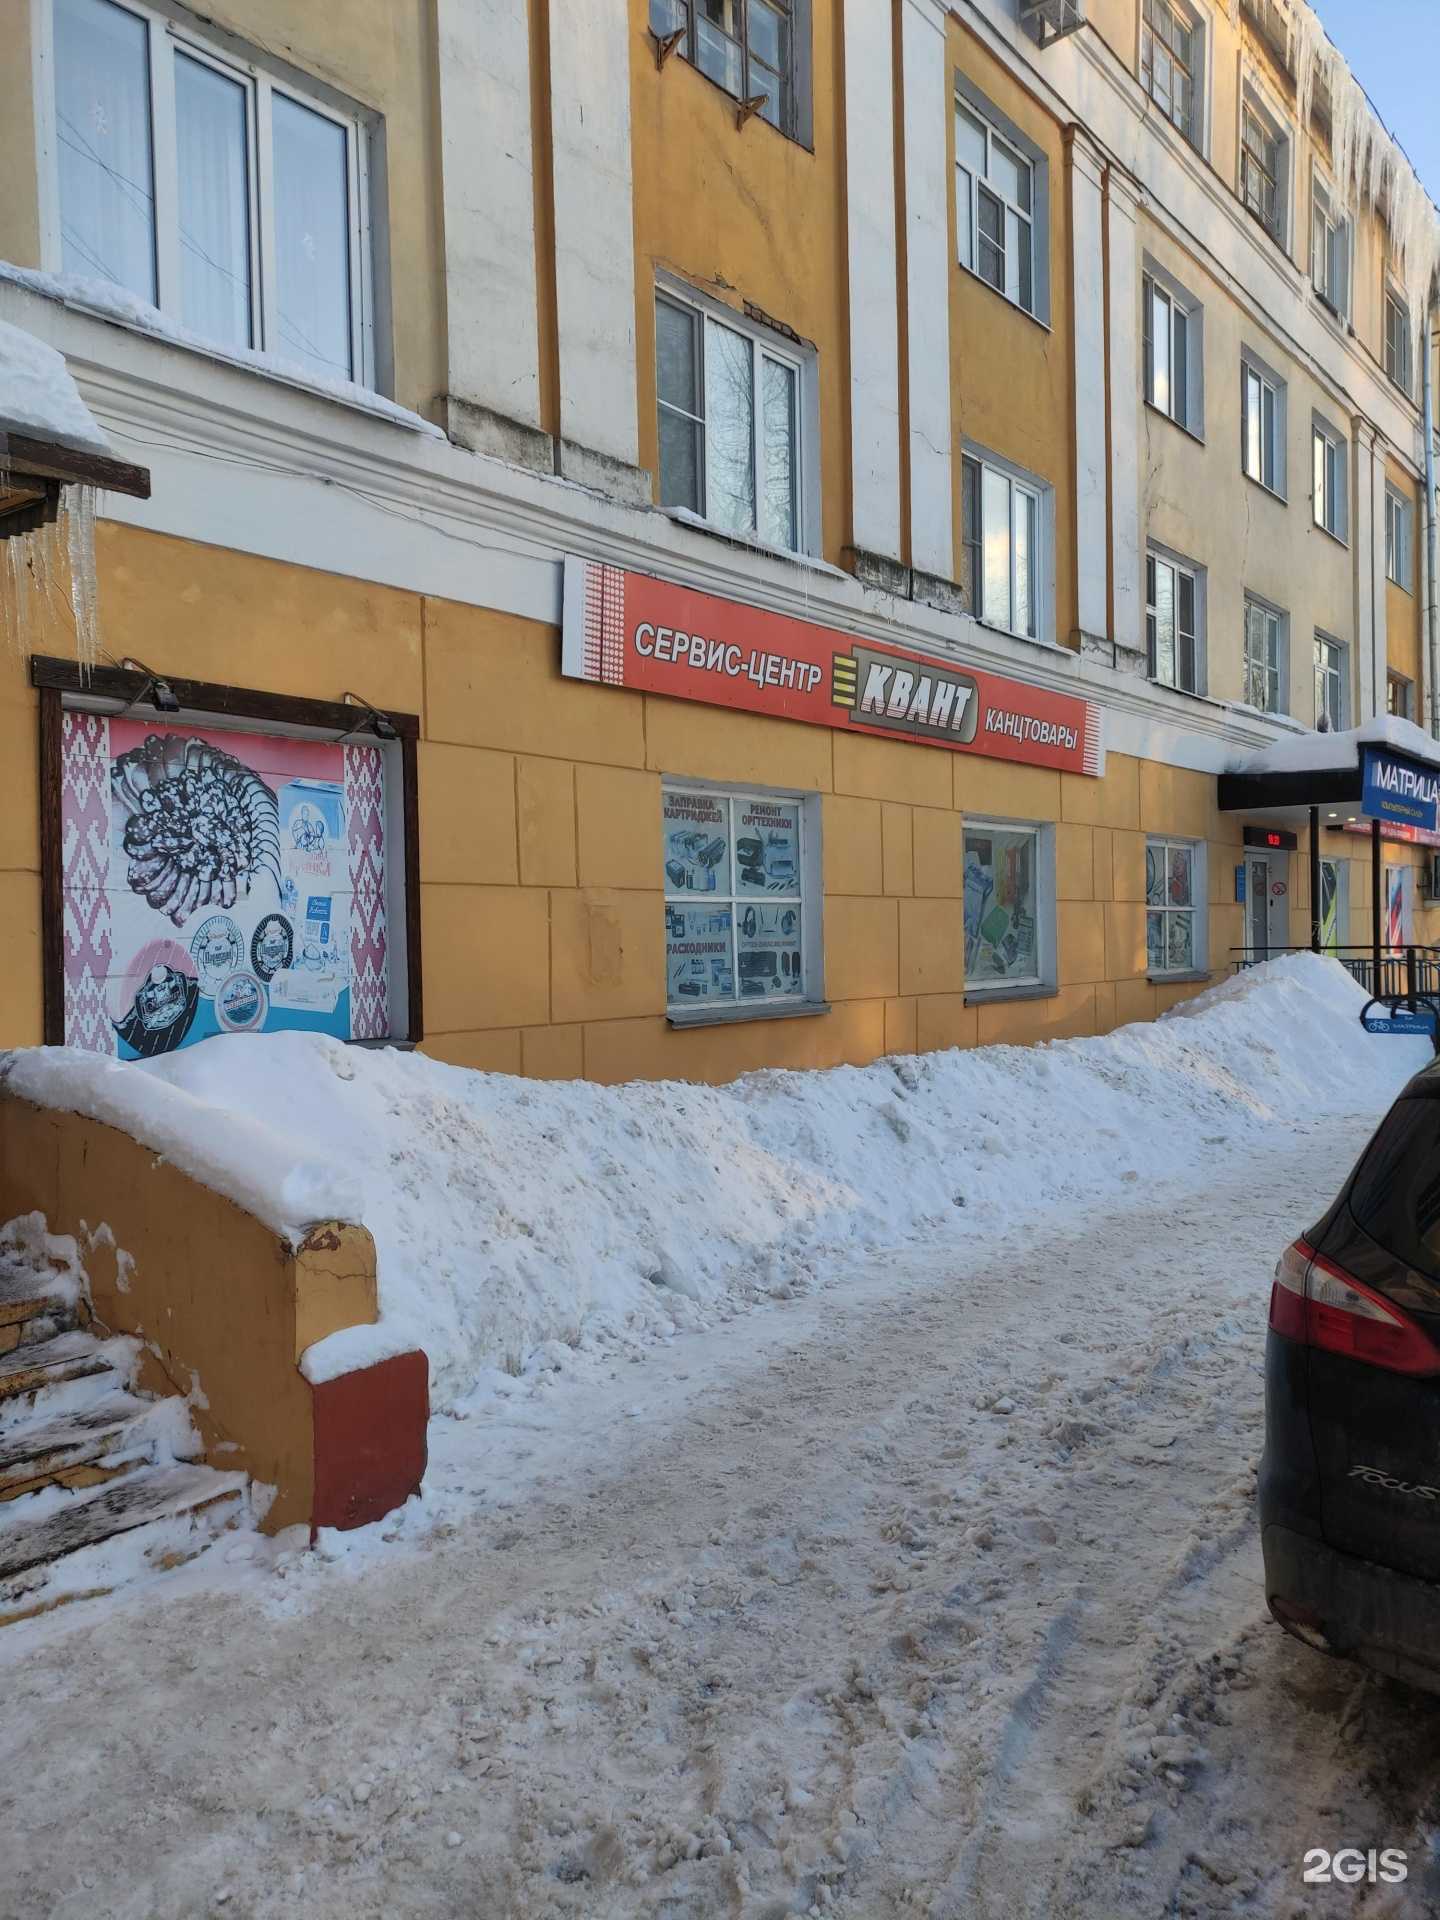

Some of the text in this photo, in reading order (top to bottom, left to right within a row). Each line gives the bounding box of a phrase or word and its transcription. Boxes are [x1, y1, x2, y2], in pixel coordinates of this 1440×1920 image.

[633, 621, 823, 693] СЕРВИС-ЦЕНТР
[859, 664, 973, 731] КВАНТ
[984, 707, 1078, 751] КАНЦТОВАРЫ
[1376, 760, 1439, 803] МАТРИЦА
[742, 815, 792, 828] ОРГТЕХНИКИ
[750, 804, 782, 816] РЕМОНТ
[666, 942, 727, 955] РАСХОДНИКИ
